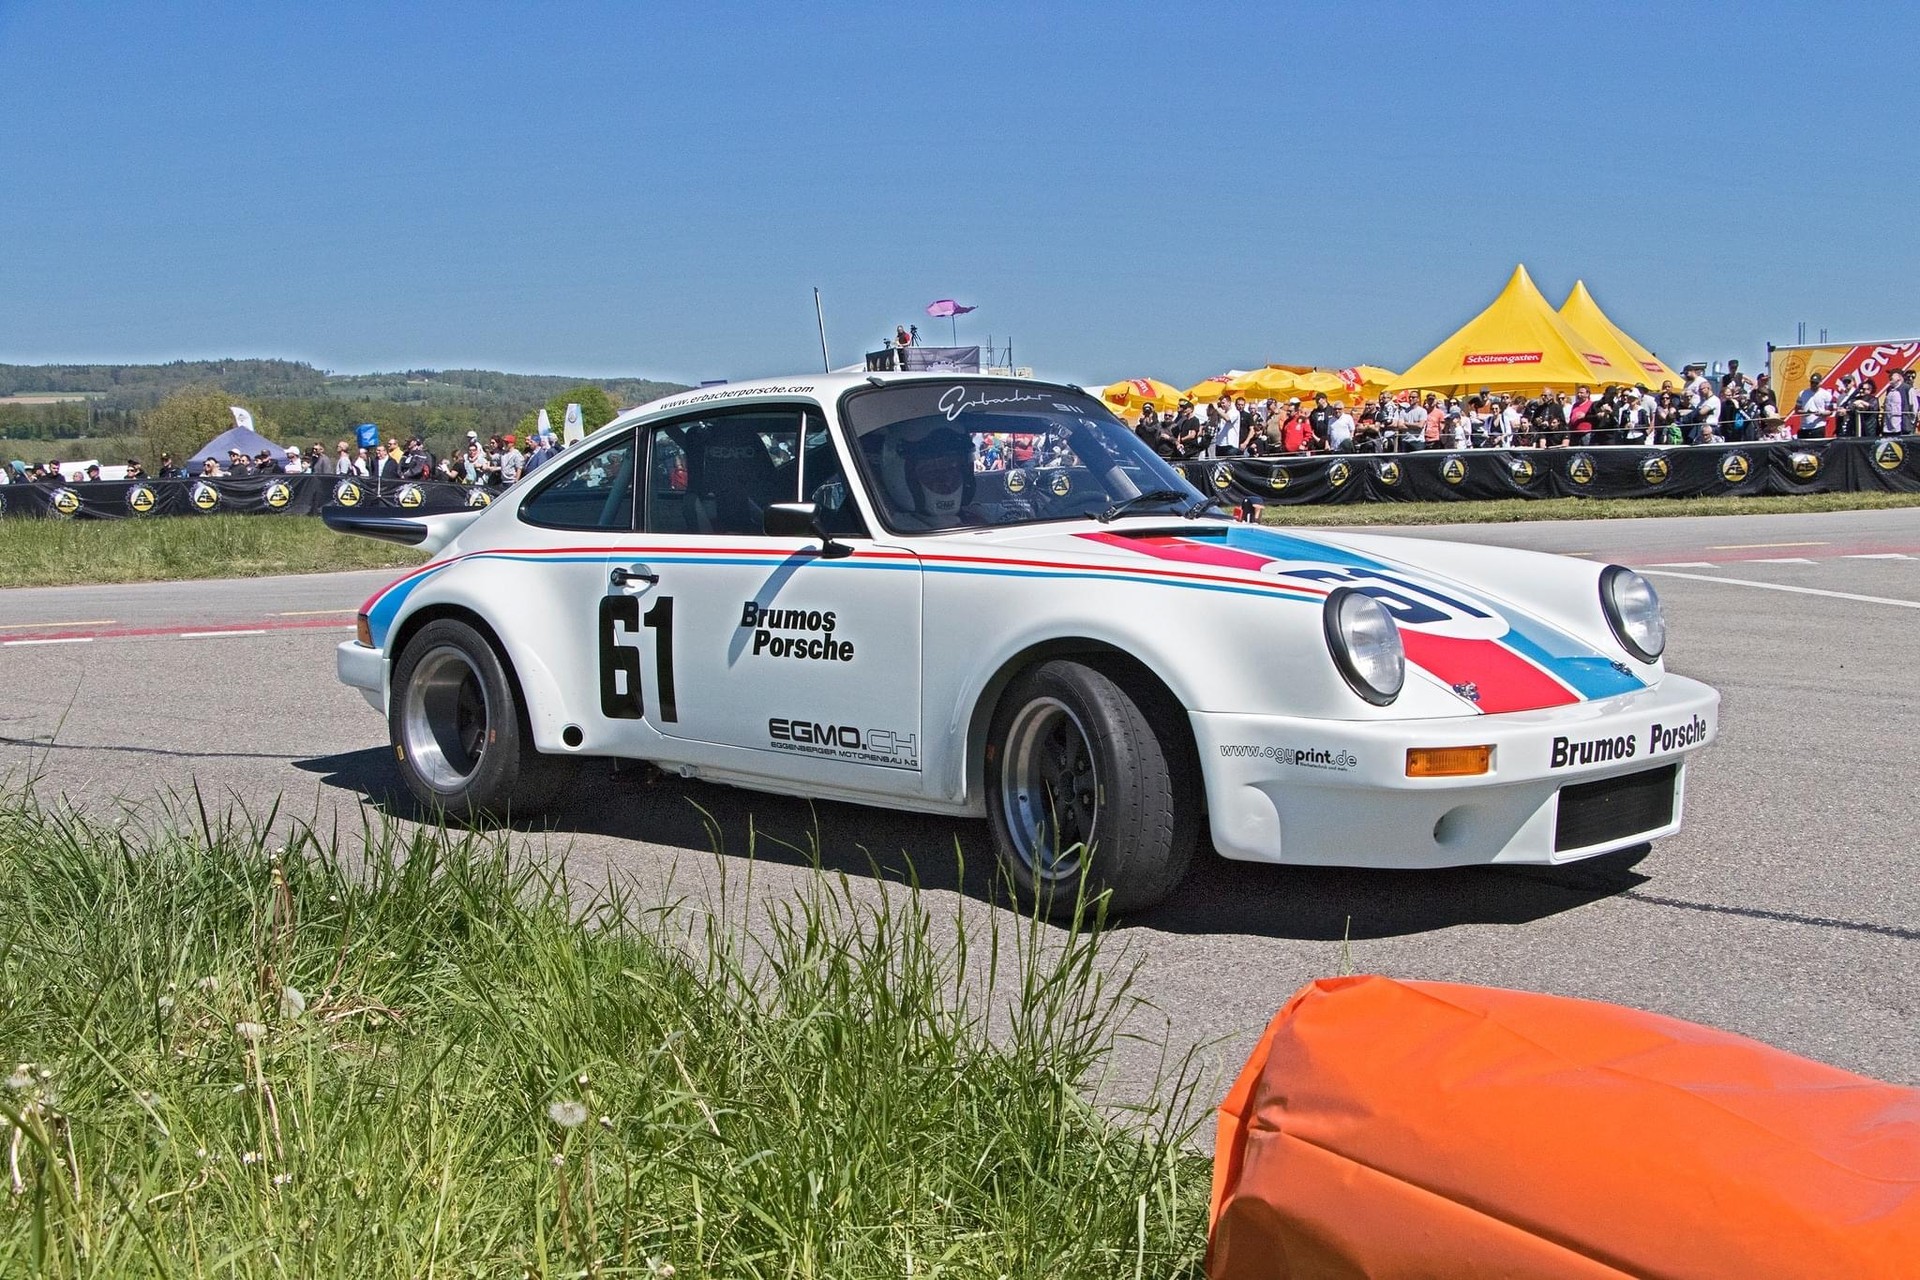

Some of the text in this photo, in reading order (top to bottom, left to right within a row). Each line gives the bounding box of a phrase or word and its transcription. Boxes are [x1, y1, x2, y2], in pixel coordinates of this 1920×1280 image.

[1467, 354, 1540, 364] Schützengarten
[660, 385, 815, 410] www.erbacherporsche.com
[1052, 403, 1084, 414] 911
[741, 601, 836, 632] Brumos
[599, 595, 678, 723] 61
[752, 630, 855, 661] Porsche
[769, 718, 917, 757] EGMO.CH
[1550, 714, 1707, 768] Brumos Porsche
[770, 741, 837, 756] EGGENBERGER
[839, 751, 902, 766] MOTORENBAU
[1220, 745, 1357, 767] www.ogyprint.de
